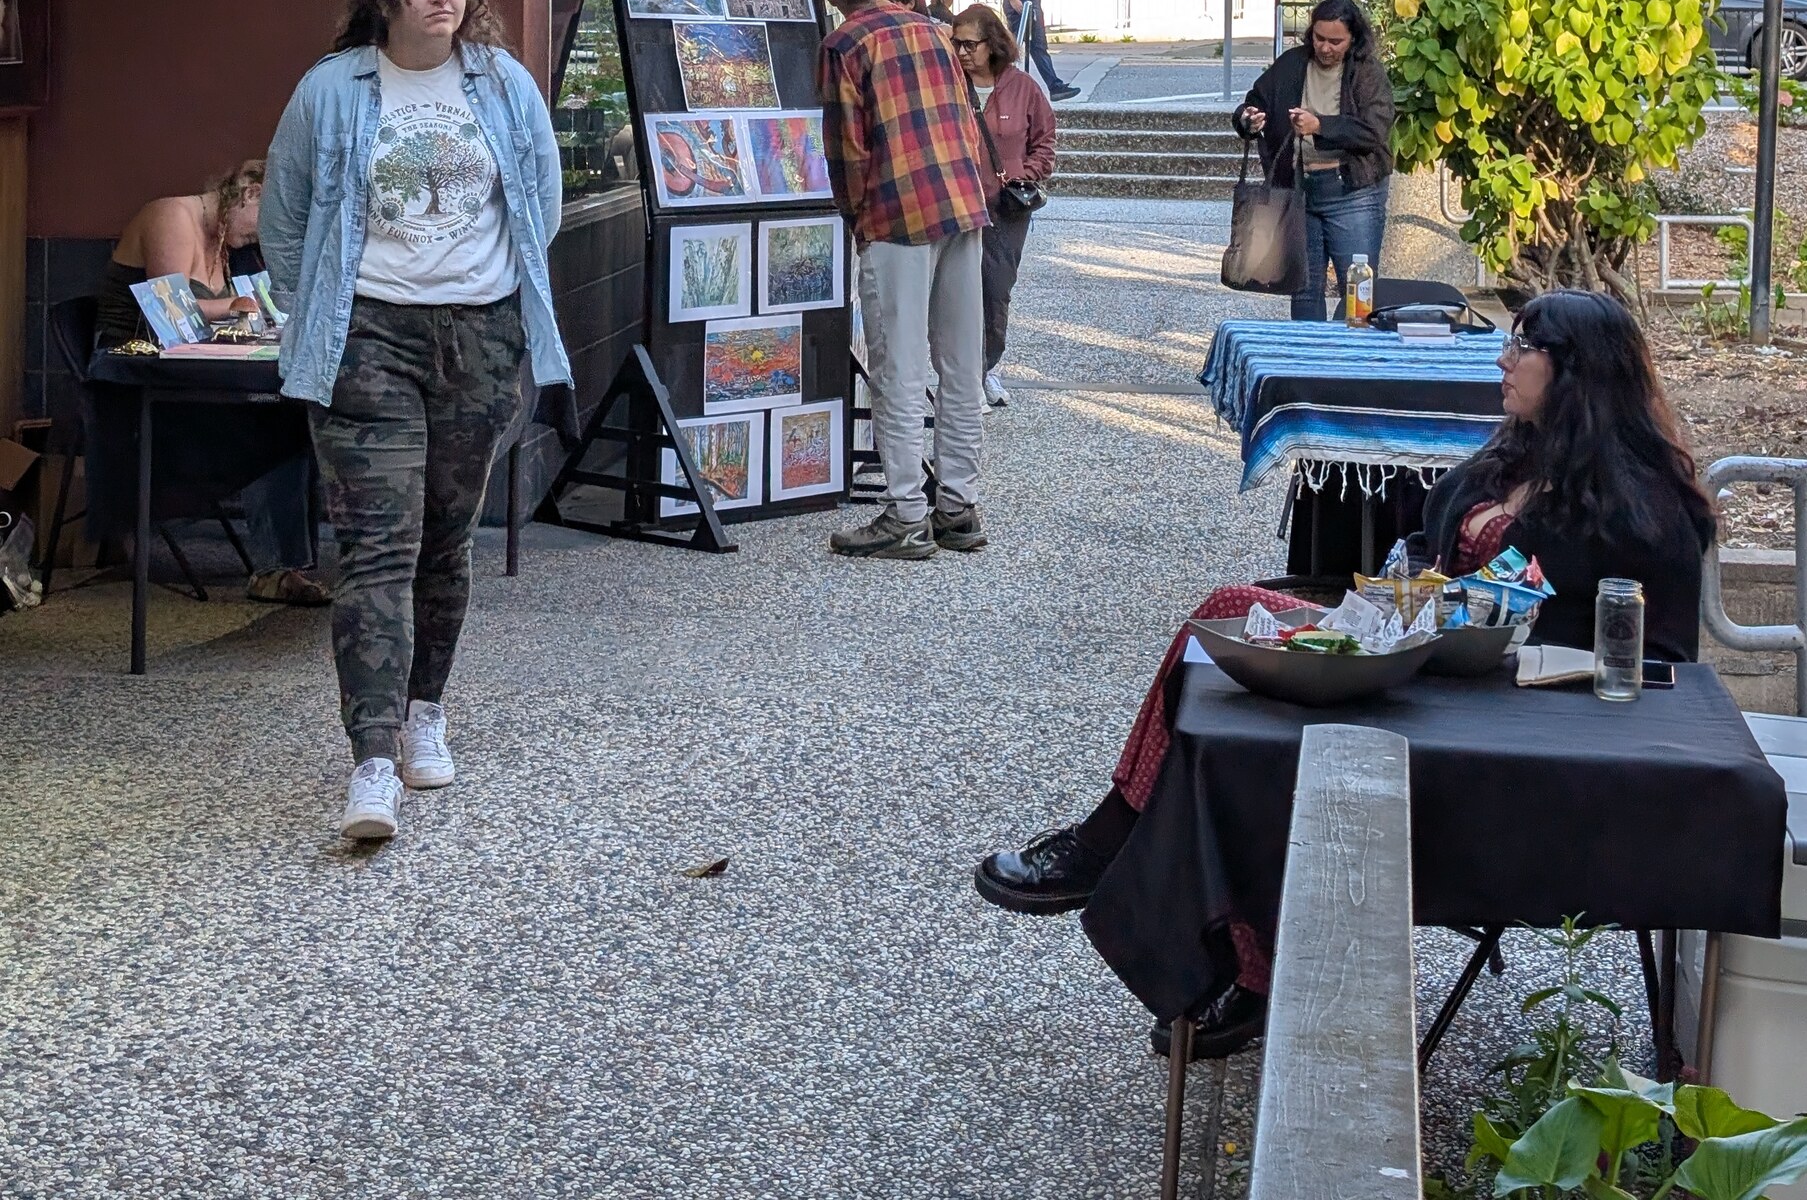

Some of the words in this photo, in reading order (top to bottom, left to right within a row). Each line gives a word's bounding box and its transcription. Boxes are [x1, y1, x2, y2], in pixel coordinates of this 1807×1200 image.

[435, 101, 471, 121] VERNAL
[401, 123, 418, 134] THE
[386, 225, 433, 244] EQUINOX
